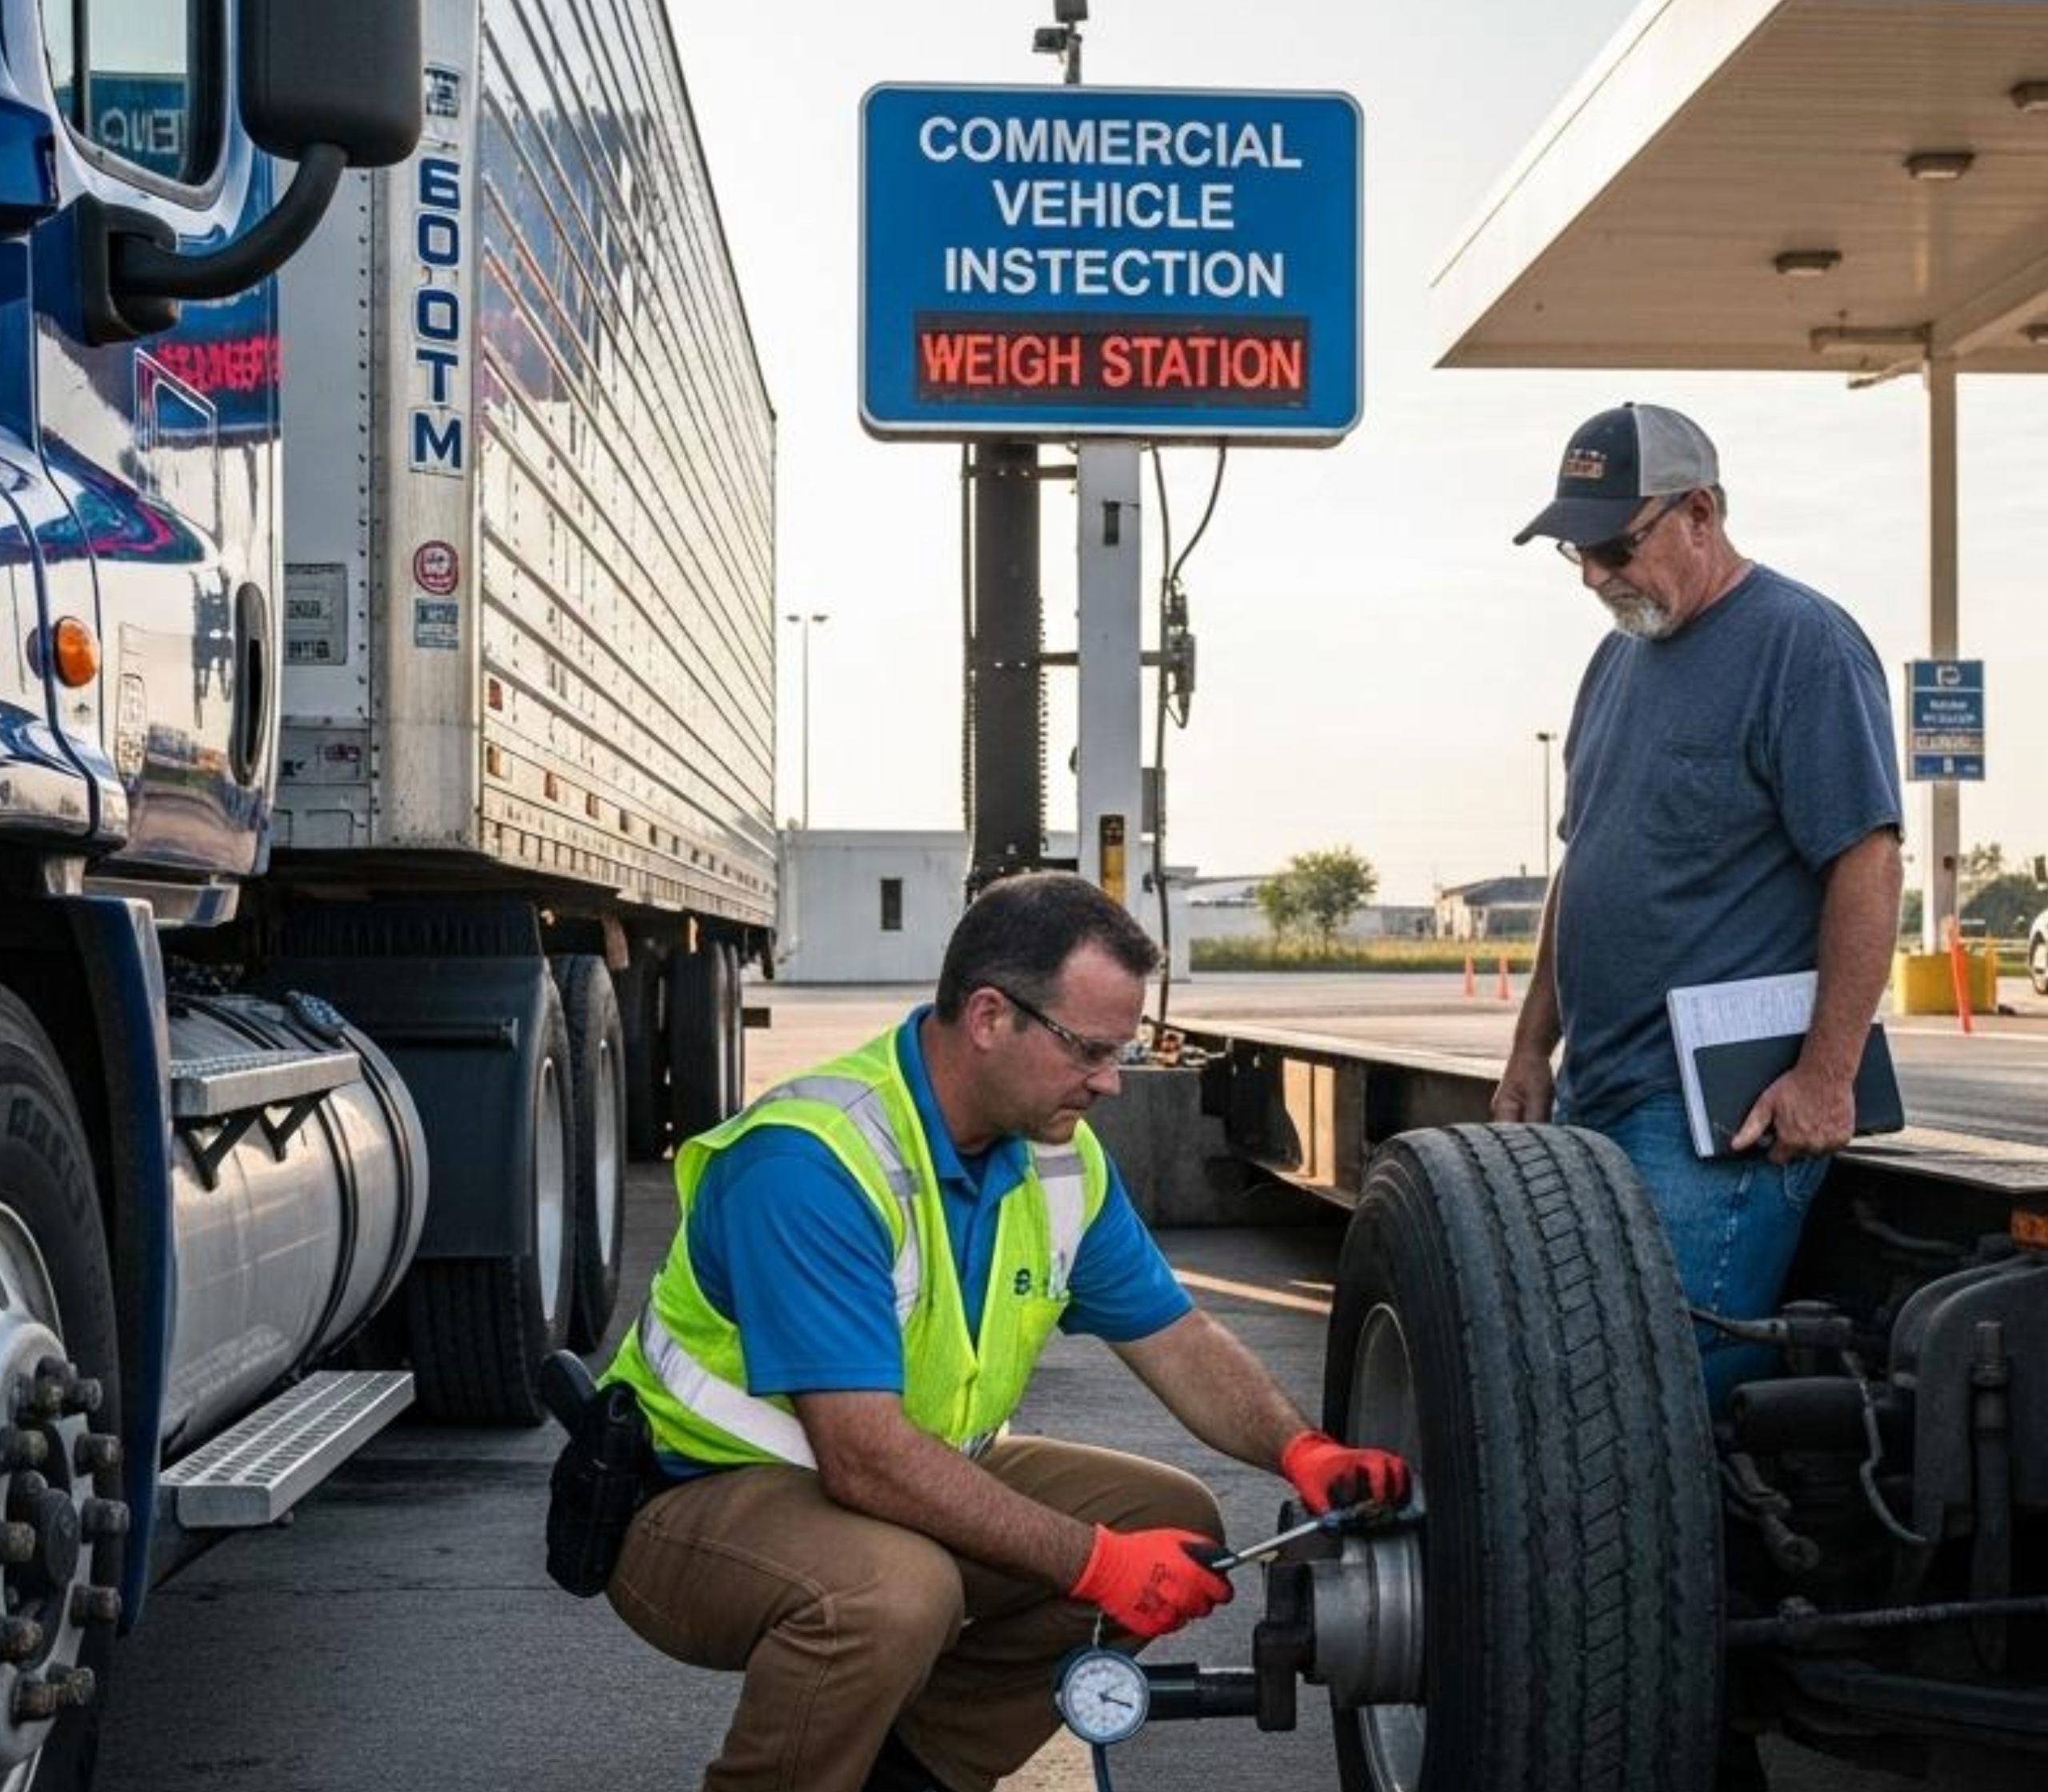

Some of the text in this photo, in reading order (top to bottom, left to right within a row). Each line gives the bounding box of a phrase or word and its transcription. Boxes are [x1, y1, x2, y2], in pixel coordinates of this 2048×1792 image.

[919, 116, 1302, 170] COMMERCIAL
[992, 179, 1234, 230] VEHICLE
[945, 247, 1283, 298] INSTECTION
[922, 334, 1302, 390] WEIGH STATION
